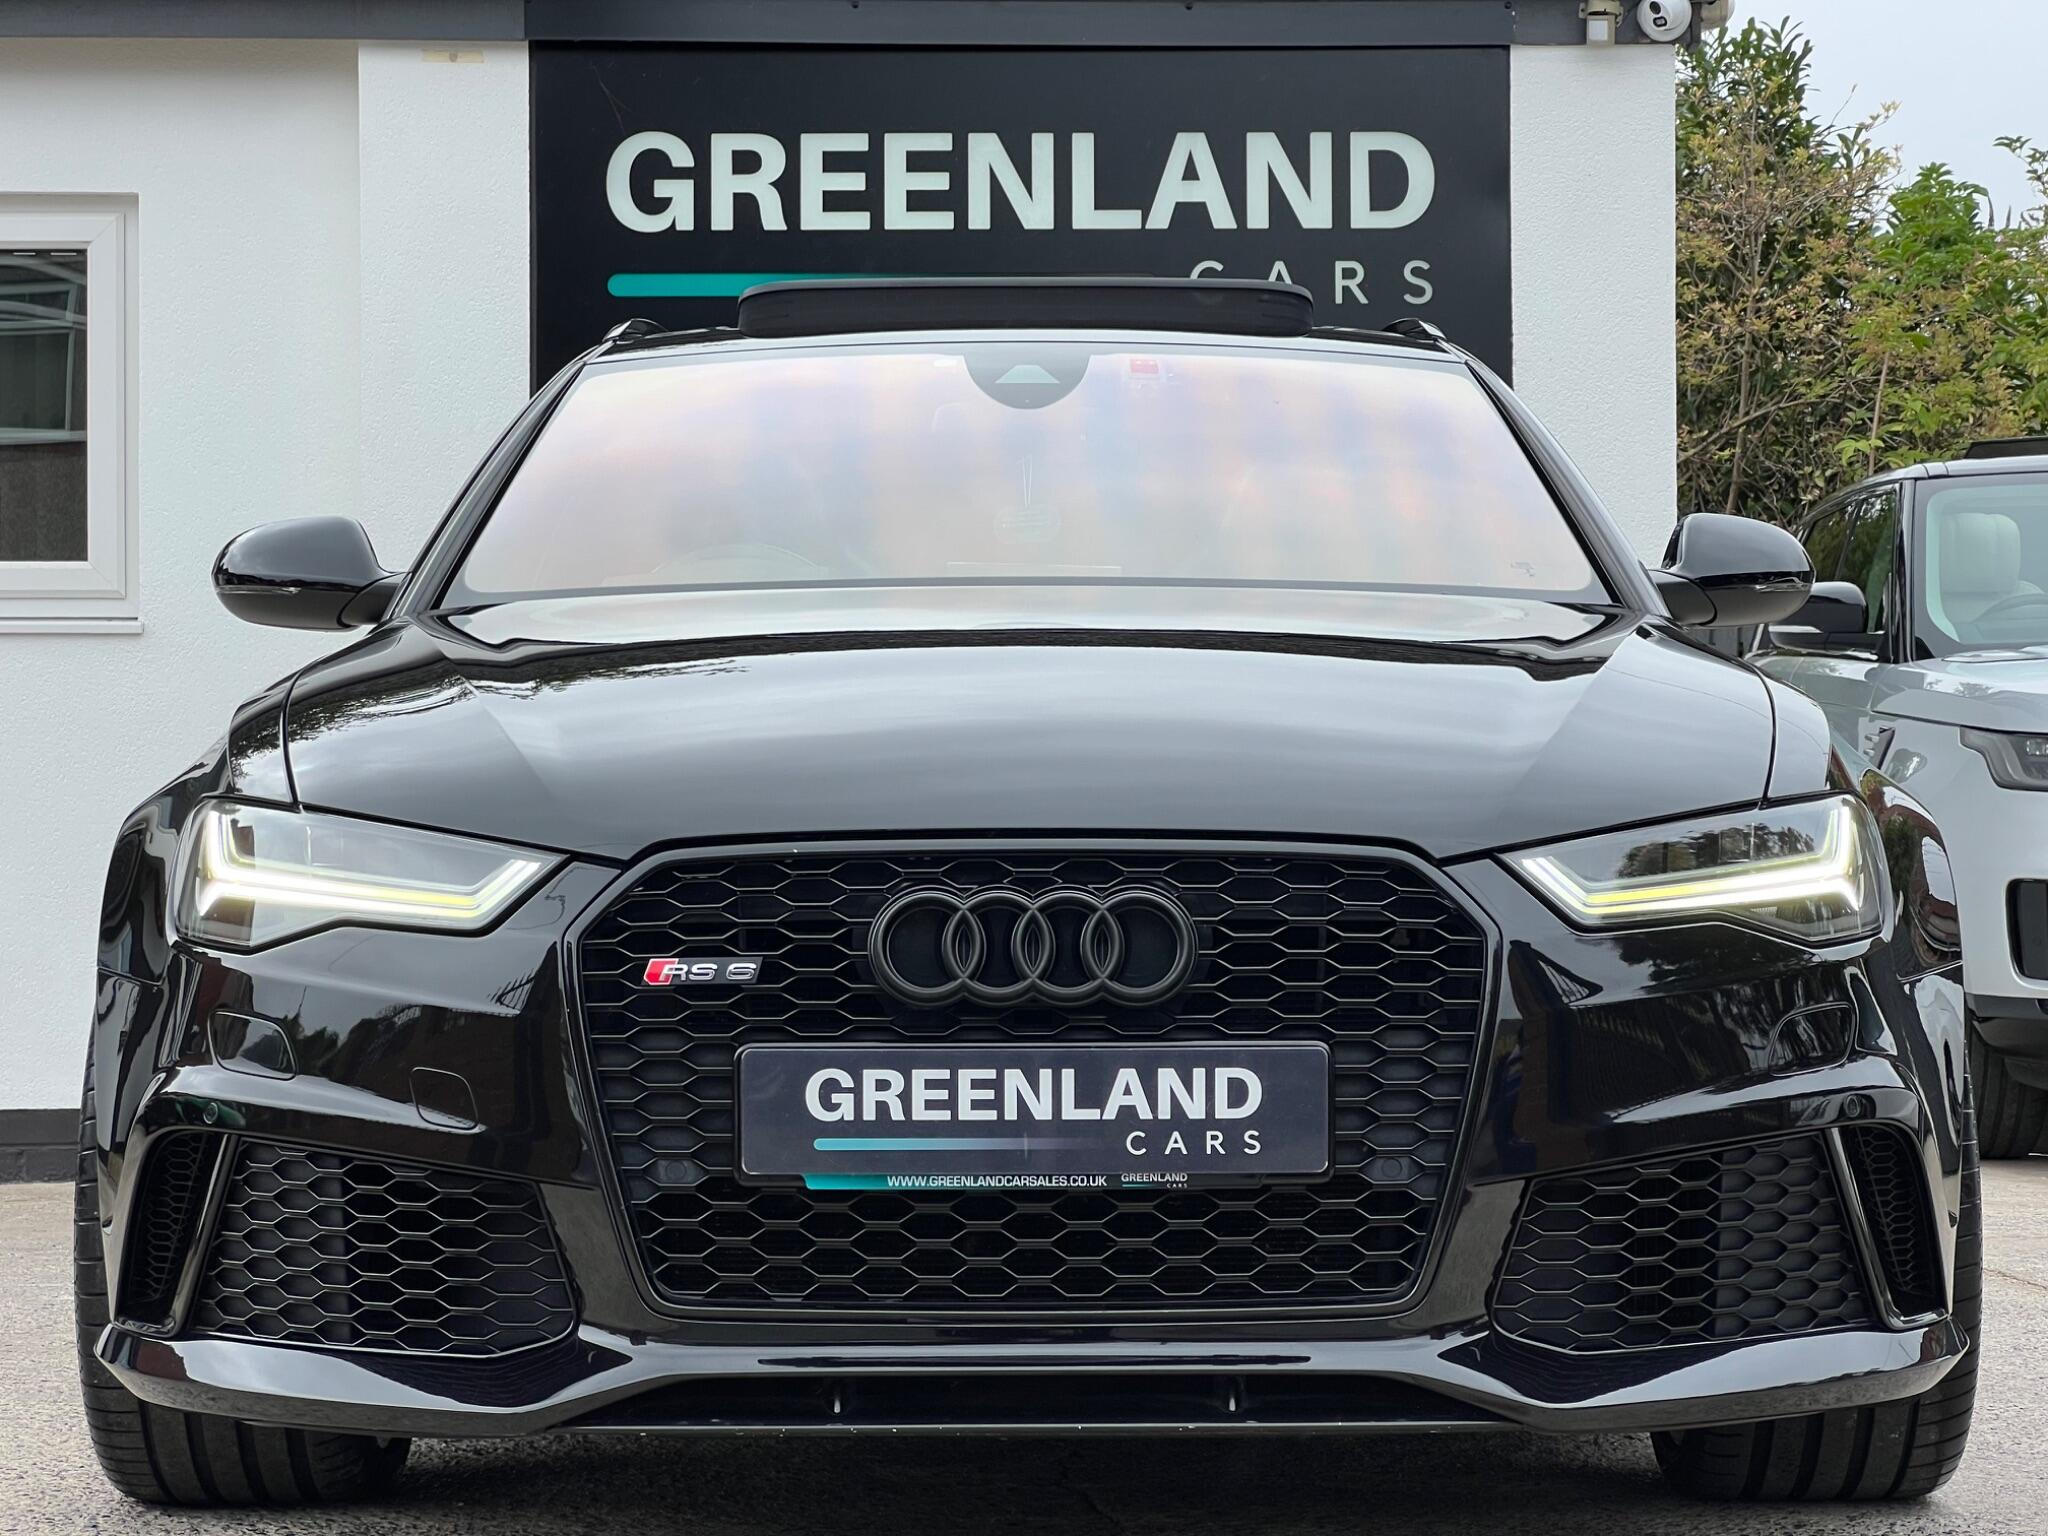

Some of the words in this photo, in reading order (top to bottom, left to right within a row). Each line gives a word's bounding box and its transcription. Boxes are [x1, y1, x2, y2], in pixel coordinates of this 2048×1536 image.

[605, 131, 1436, 233] GREENLAND
[658, 963, 718, 981] RS
[726, 962, 757, 980] 6
[804, 1067, 1263, 1122] GREENLAND
[1125, 1130, 1262, 1156] CARS
[886, 1175, 1108, 1188] WWW.GREENLANDCARSALES.CO.UK
[1120, 1172, 1188, 1182] GREENLAND
